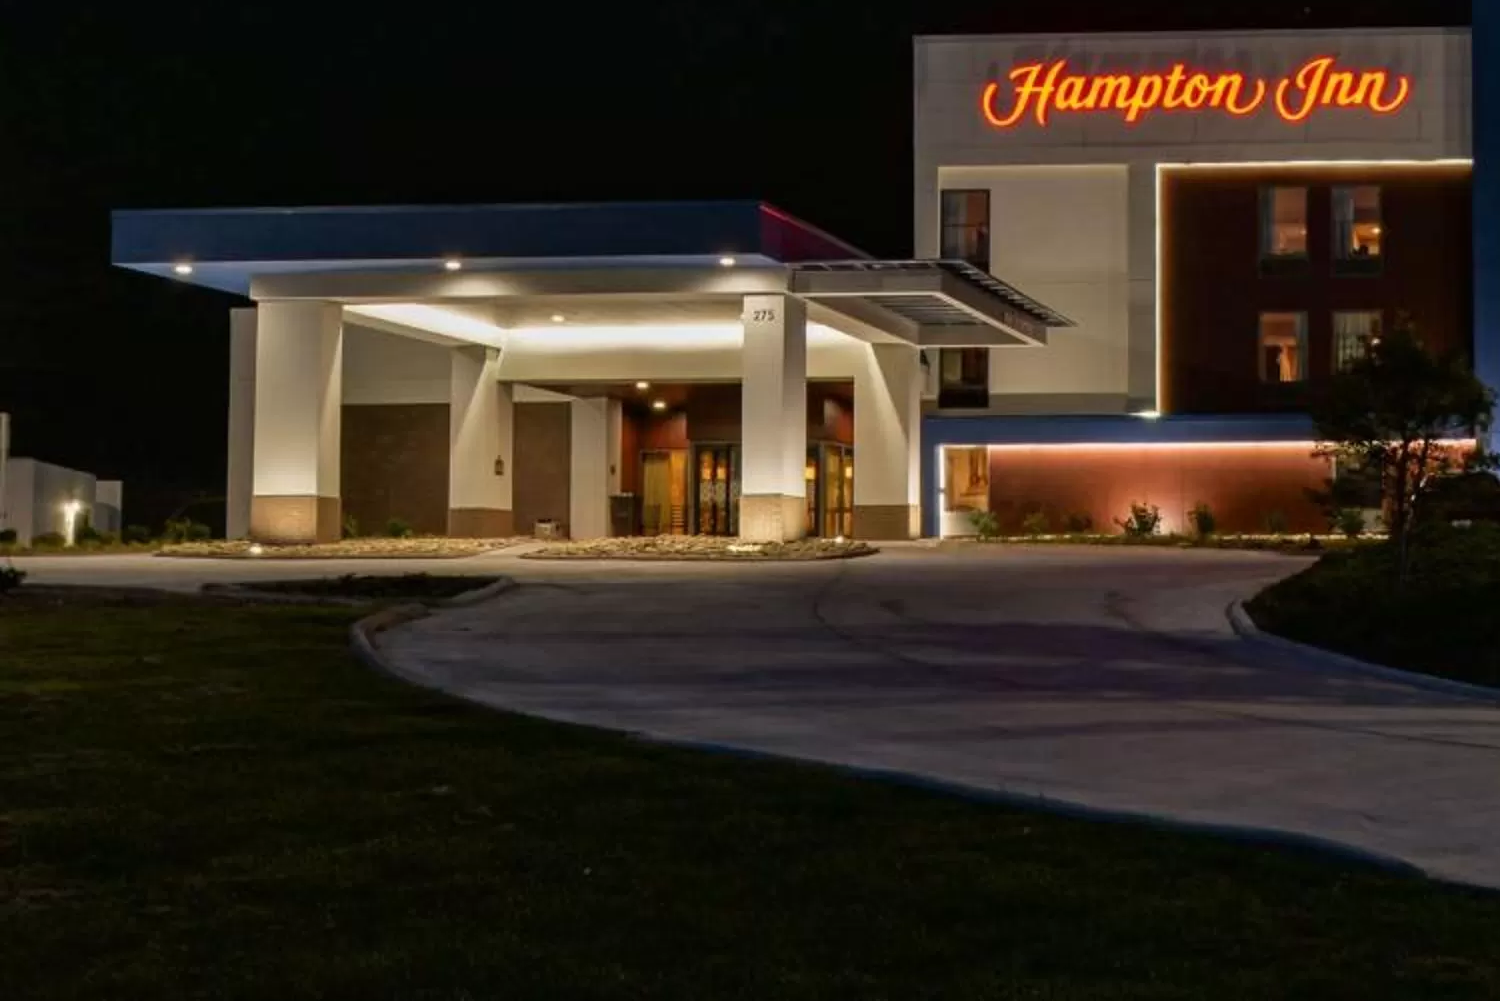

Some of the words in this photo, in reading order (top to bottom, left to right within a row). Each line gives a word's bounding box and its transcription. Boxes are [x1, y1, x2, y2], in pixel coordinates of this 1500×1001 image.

[982, 60, 1266, 127] Hampton
[1275, 57, 1409, 123] Inn
[752, 309, 775, 321] 275
